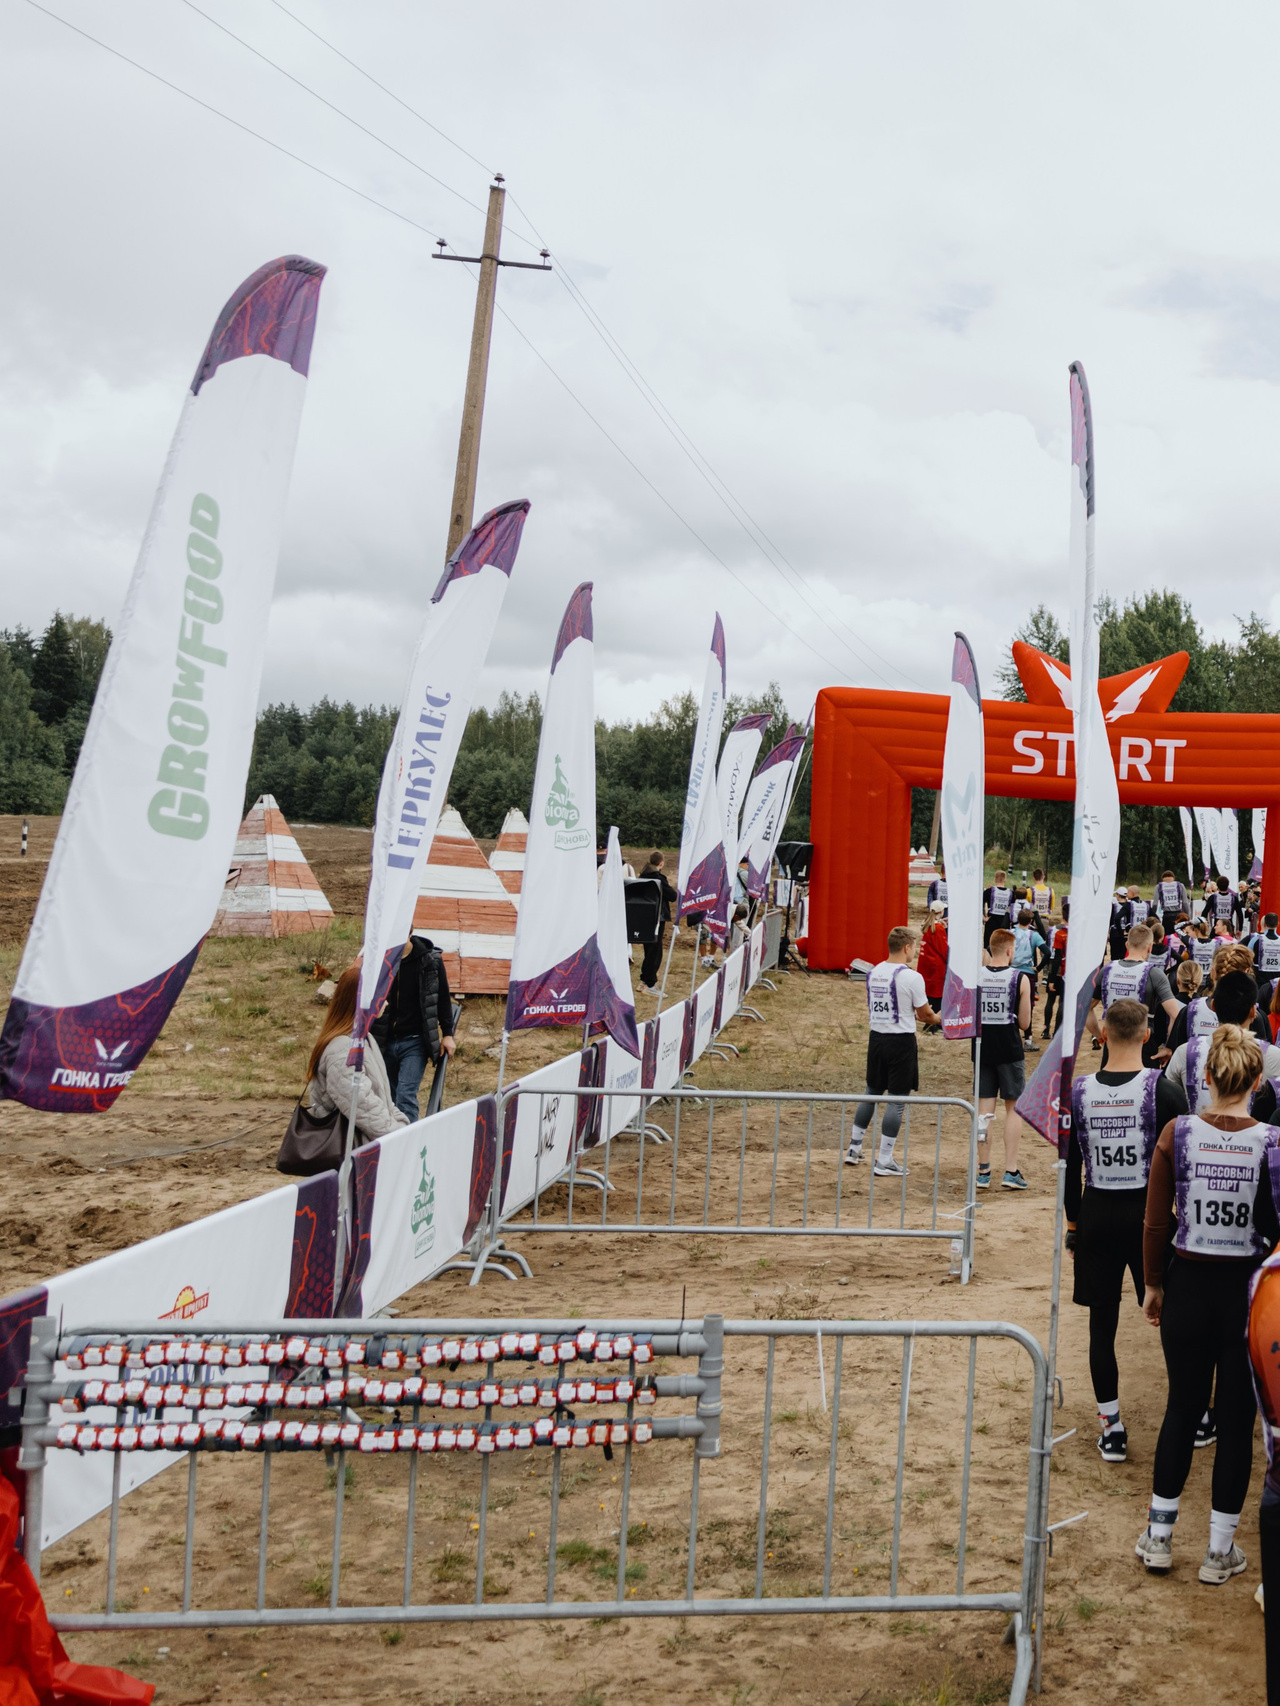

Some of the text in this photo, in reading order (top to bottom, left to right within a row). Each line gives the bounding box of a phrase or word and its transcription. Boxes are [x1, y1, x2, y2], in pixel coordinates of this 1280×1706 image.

[1012, 730, 1187, 782] STRT
[1266, 958, 1279, 966] 825
[524, 1004, 586, 1015] ГОНКА ГЕРОЕВ
[982, 1002, 1005, 1013] 1551
[52, 1068, 136, 1088] ГОНКА ГЕРОЕ
[1091, 1116, 1135, 1128] МАССОВЫЙ
[1102, 1128, 1125, 1138] СТАРТ
[1199, 1142, 1253, 1153] ГОНКА ГЕРОЕВ
[1094, 1145, 1137, 1167] 1545
[1196, 1164, 1252, 1180] МАССОВЫЙ
[1209, 1179, 1238, 1191] СТАРТ
[1194, 1199, 1250, 1228] 1358
